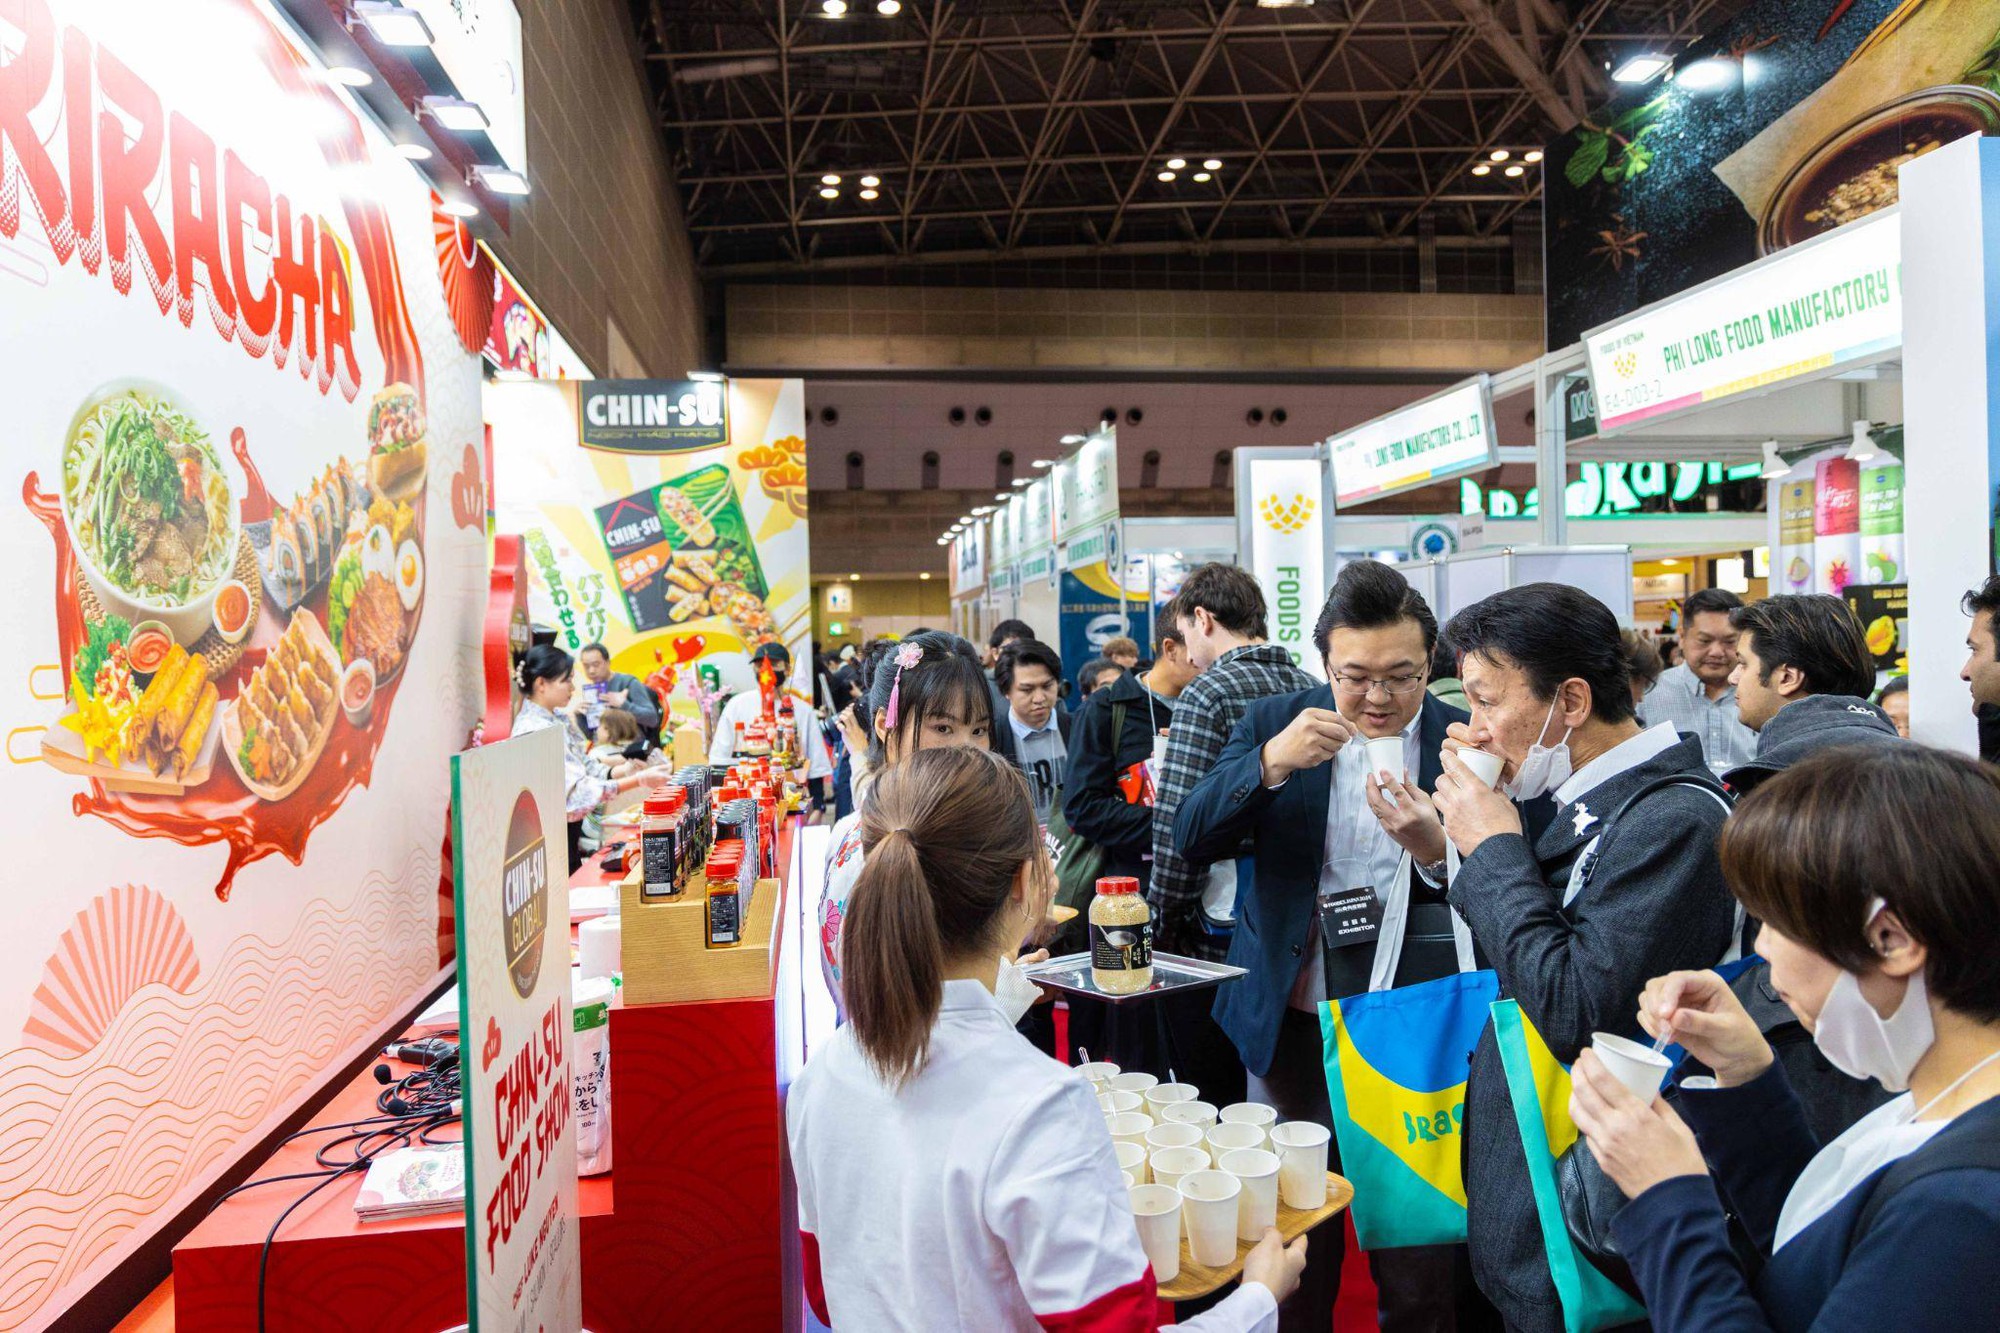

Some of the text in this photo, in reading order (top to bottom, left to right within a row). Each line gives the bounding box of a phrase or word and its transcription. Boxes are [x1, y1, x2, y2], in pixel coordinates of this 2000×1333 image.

[1663, 267, 1890, 373] PHI LONG FOOD MANUFACTORY
[586, 394, 721, 427] CHIN-SU
[606, 515, 661, 547] CHIN-SU
[1277, 566, 1302, 642] FOODS
[505, 846, 546, 917] CHIN-SU
[512, 895, 544, 953] GLOBAL
[494, 995, 563, 1161] CHIN-SU
[486, 1061, 570, 1276] FOOD SHOW
